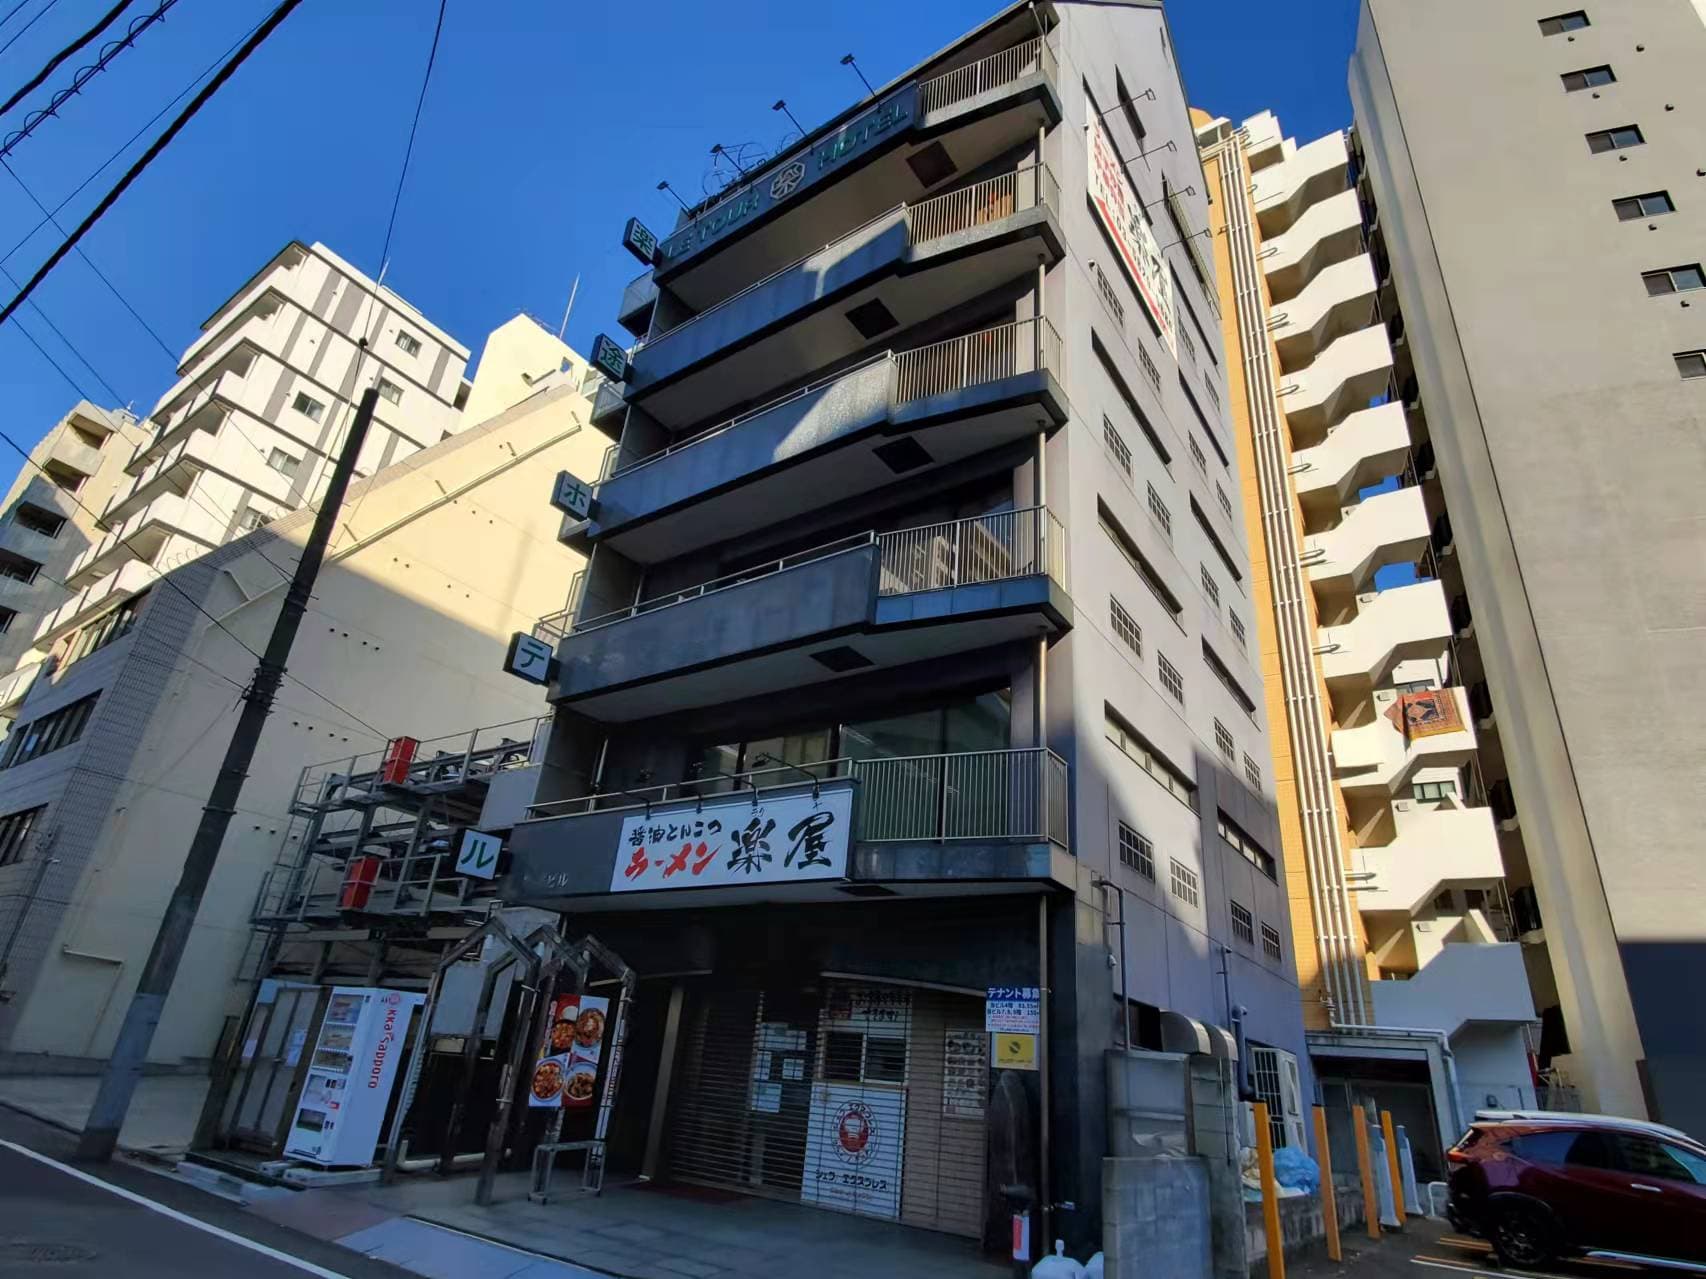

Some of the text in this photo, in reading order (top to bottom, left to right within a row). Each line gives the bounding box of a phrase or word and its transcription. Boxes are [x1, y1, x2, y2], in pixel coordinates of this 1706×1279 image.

[631, 223, 654, 259] 楽
[600, 339, 623, 375] 途
[563, 484, 588, 509] ホ
[519, 644, 546, 669] テ
[628, 818, 723, 847] 醤油とんこつ
[727, 810, 835, 875] 楽屋
[460, 838, 494, 869] ル
[624, 841, 723, 882] ラーメン
